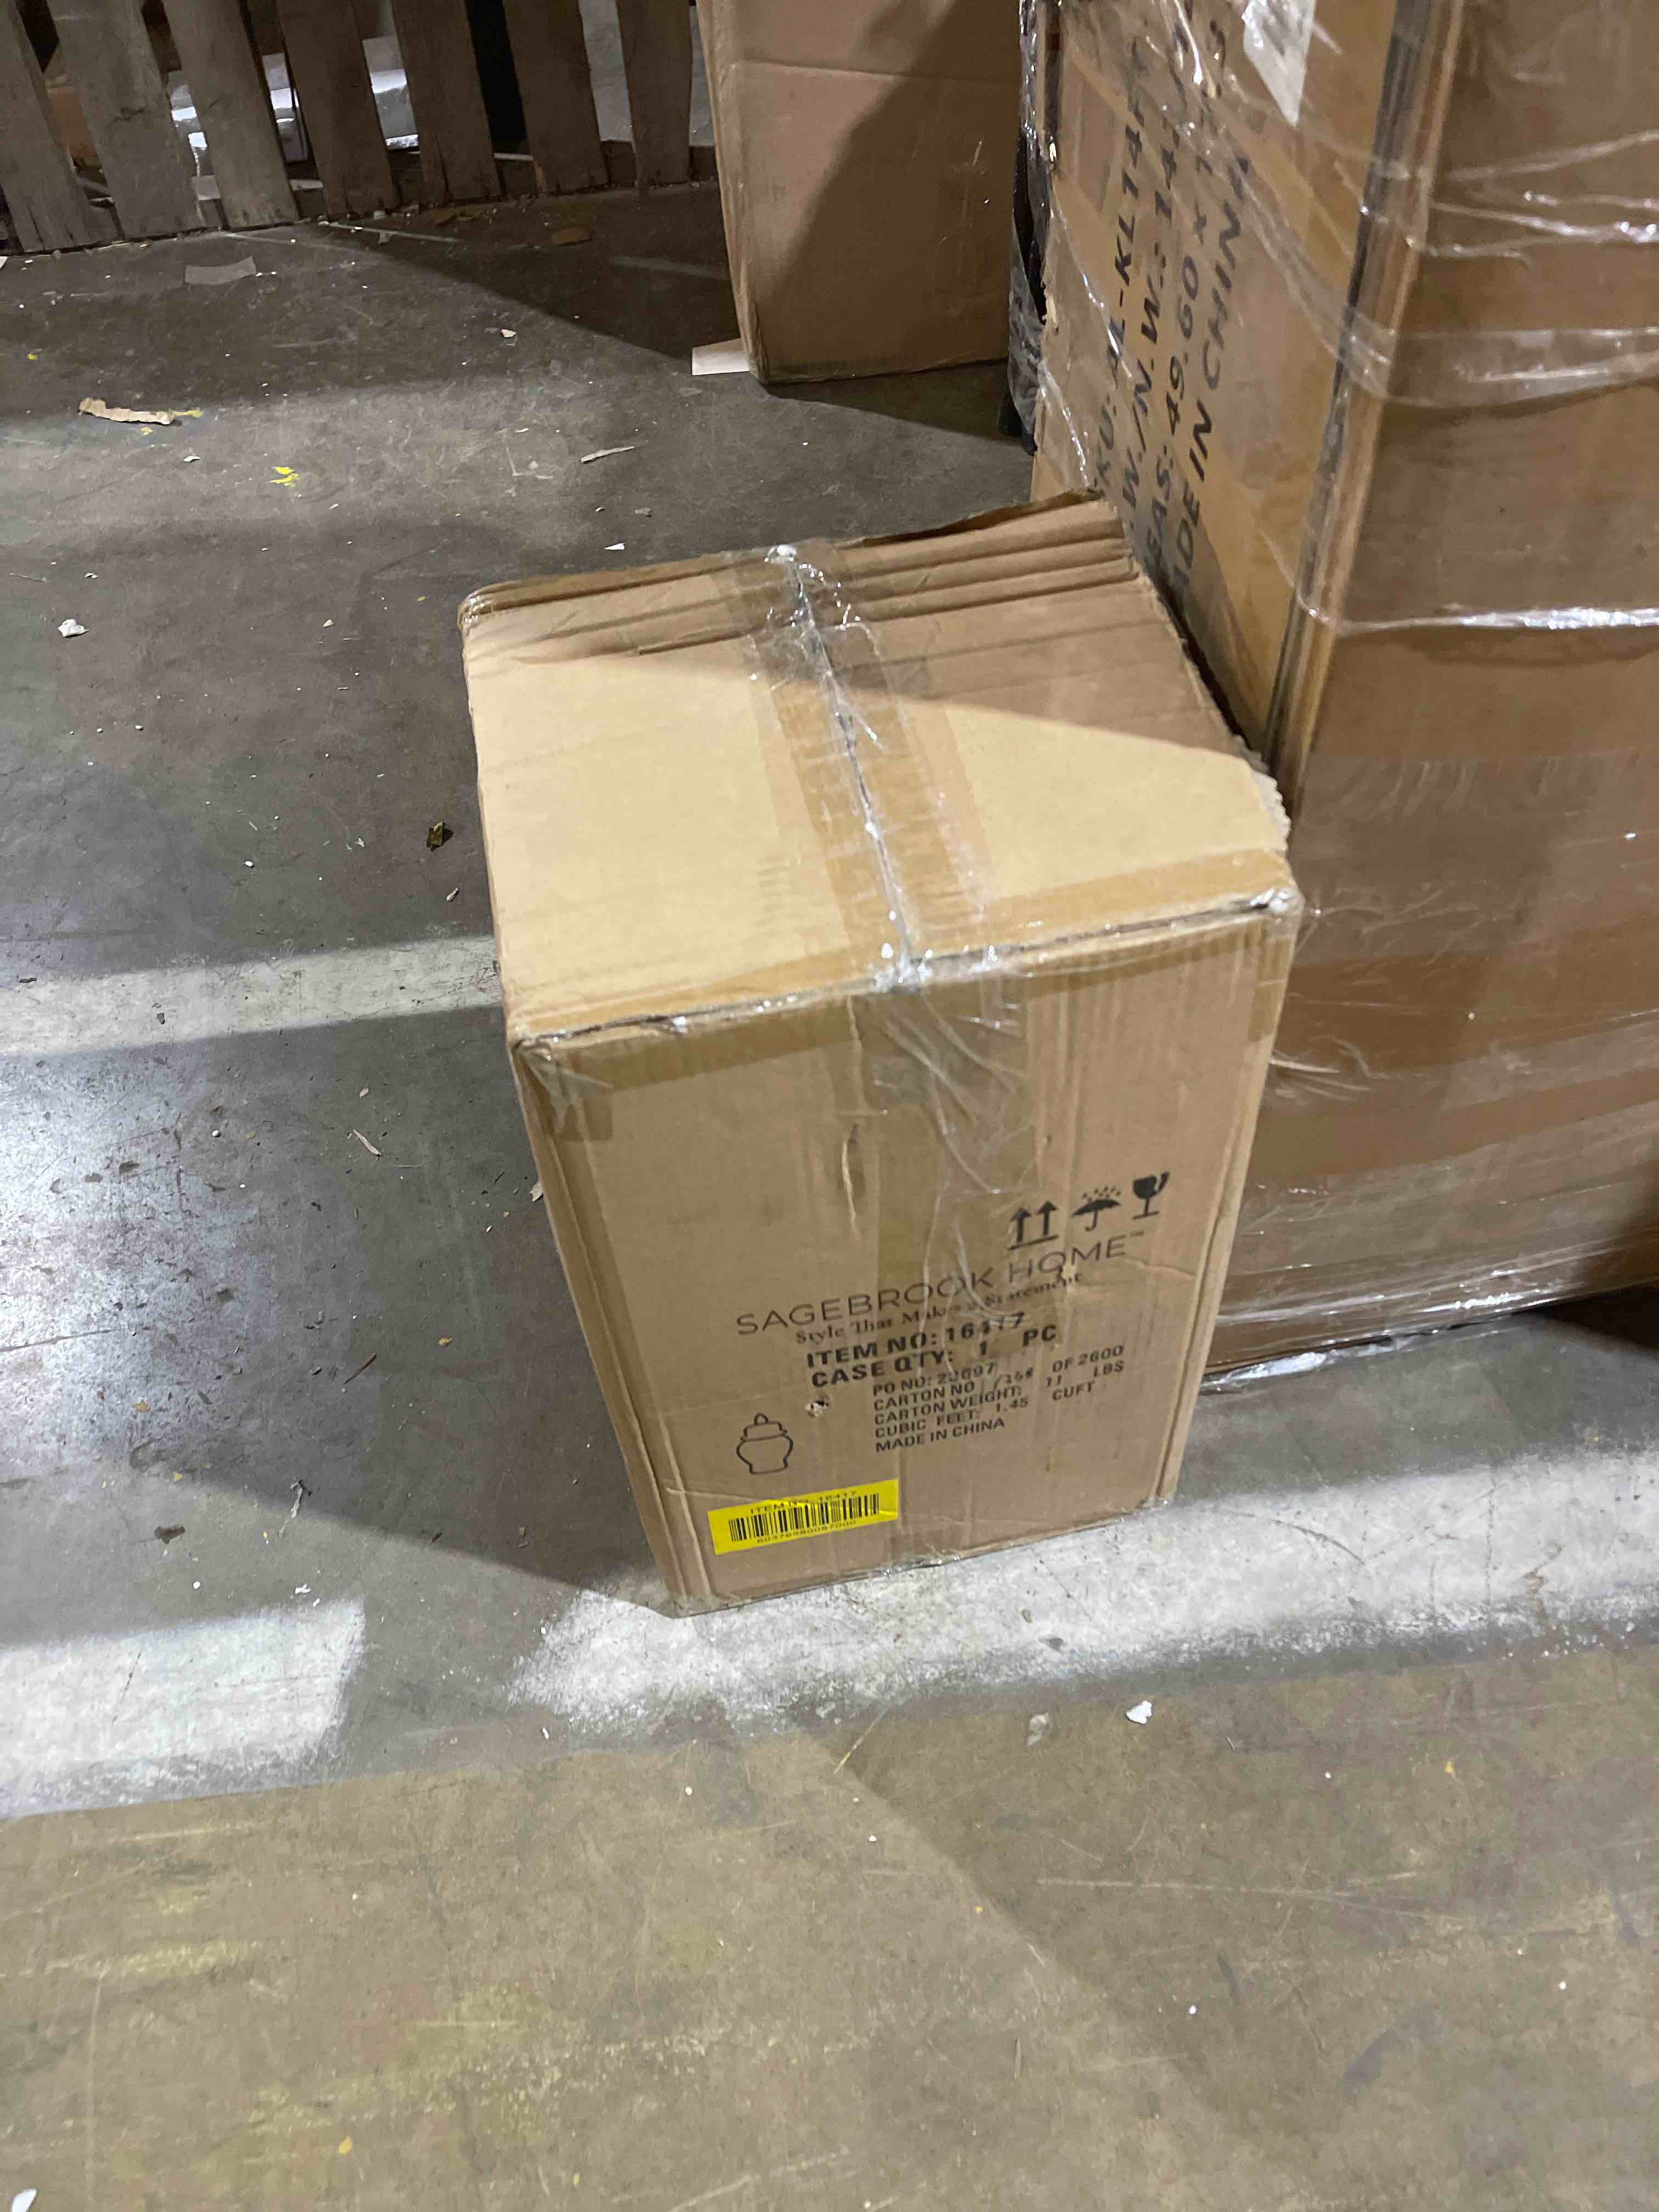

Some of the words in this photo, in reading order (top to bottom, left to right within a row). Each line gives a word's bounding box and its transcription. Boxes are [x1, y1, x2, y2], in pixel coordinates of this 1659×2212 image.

[1189, 397, 1212, 482] IN
[1202, 157, 1250, 391] CHINA
[1094, 391, 1117, 488] KU:
[1144, 443, 1173, 568] EAS:
[1166, 255, 1199, 437] 49.60
[737, 1267, 994, 1335] SAGEBROOK
[795, 1324, 844, 1345] Style
[850, 1318, 893, 1335] That
[806, 1342, 878, 1368] ITEM
[887, 1332, 938, 1354] NO:
[811, 1360, 886, 1387] CASE
[894, 1350, 953, 1373] QTY:
[978, 1340, 988, 1356] 1
[1022, 1324, 1057, 1347] PC
[874, 1386, 945, 1412] CARTON
[951, 1380, 975, 1396] NO
[1052, 1356, 1074, 1373] OF
[1077, 1345, 1124, 1366] 2600
[873, 1381, 896, 1396] PO
[874, 1401, 945, 1426] CARTON
[1092, 1359, 1124, 1378] LBS
[875, 1419, 927, 1439] CUBIC
[996, 1396, 1029, 1414] 1.45
[1052, 1379, 1096, 1401] CUFT
[876, 1433, 926, 1452] MADE
[930, 1429, 948, 1442] IN
[952, 1417, 1006, 1438] CHINA
